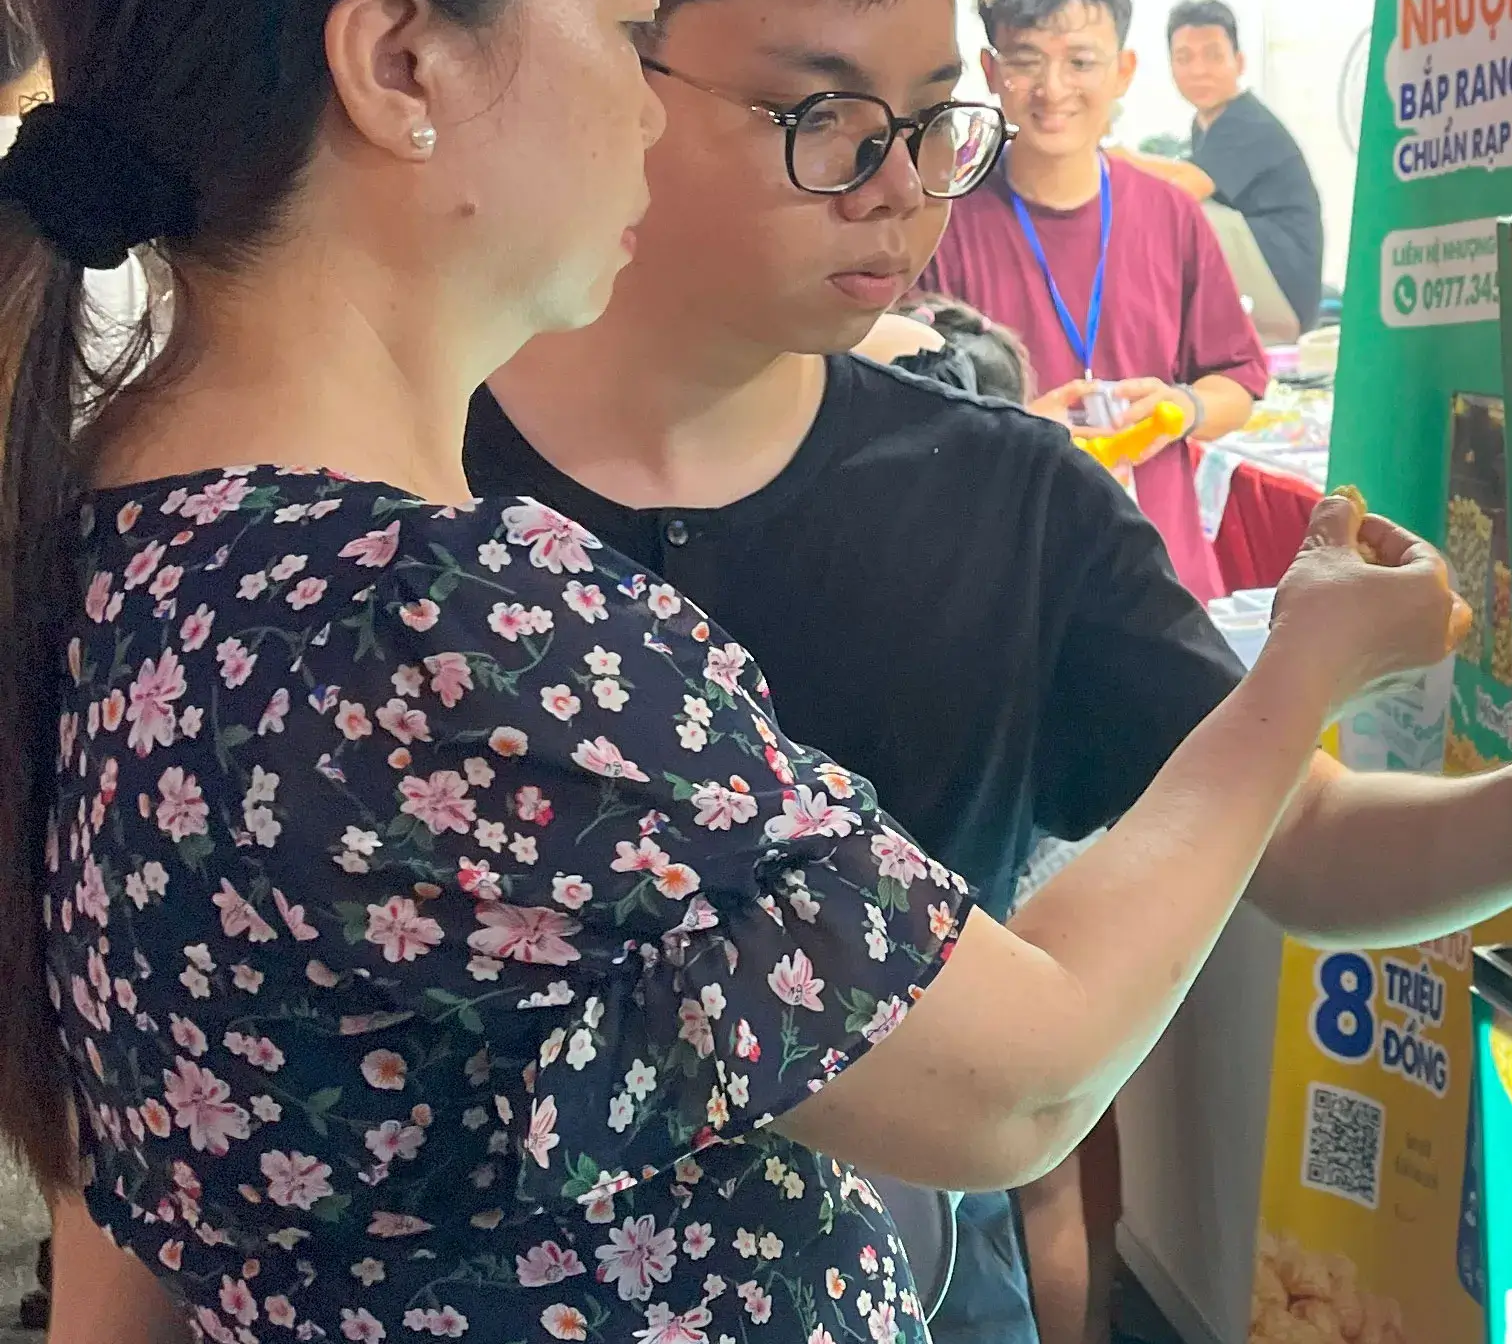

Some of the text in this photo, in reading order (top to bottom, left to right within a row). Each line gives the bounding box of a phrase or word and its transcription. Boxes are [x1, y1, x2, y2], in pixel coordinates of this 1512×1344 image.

[1400, 54, 1449, 121] BẮP
[1399, 117, 1467, 174] CHUẨN
[1471, 121, 1511, 172] RẠP
[1315, 952, 1444, 1058] 8 TRIỆU
[1382, 1017, 1448, 1092] ĐỒNG
